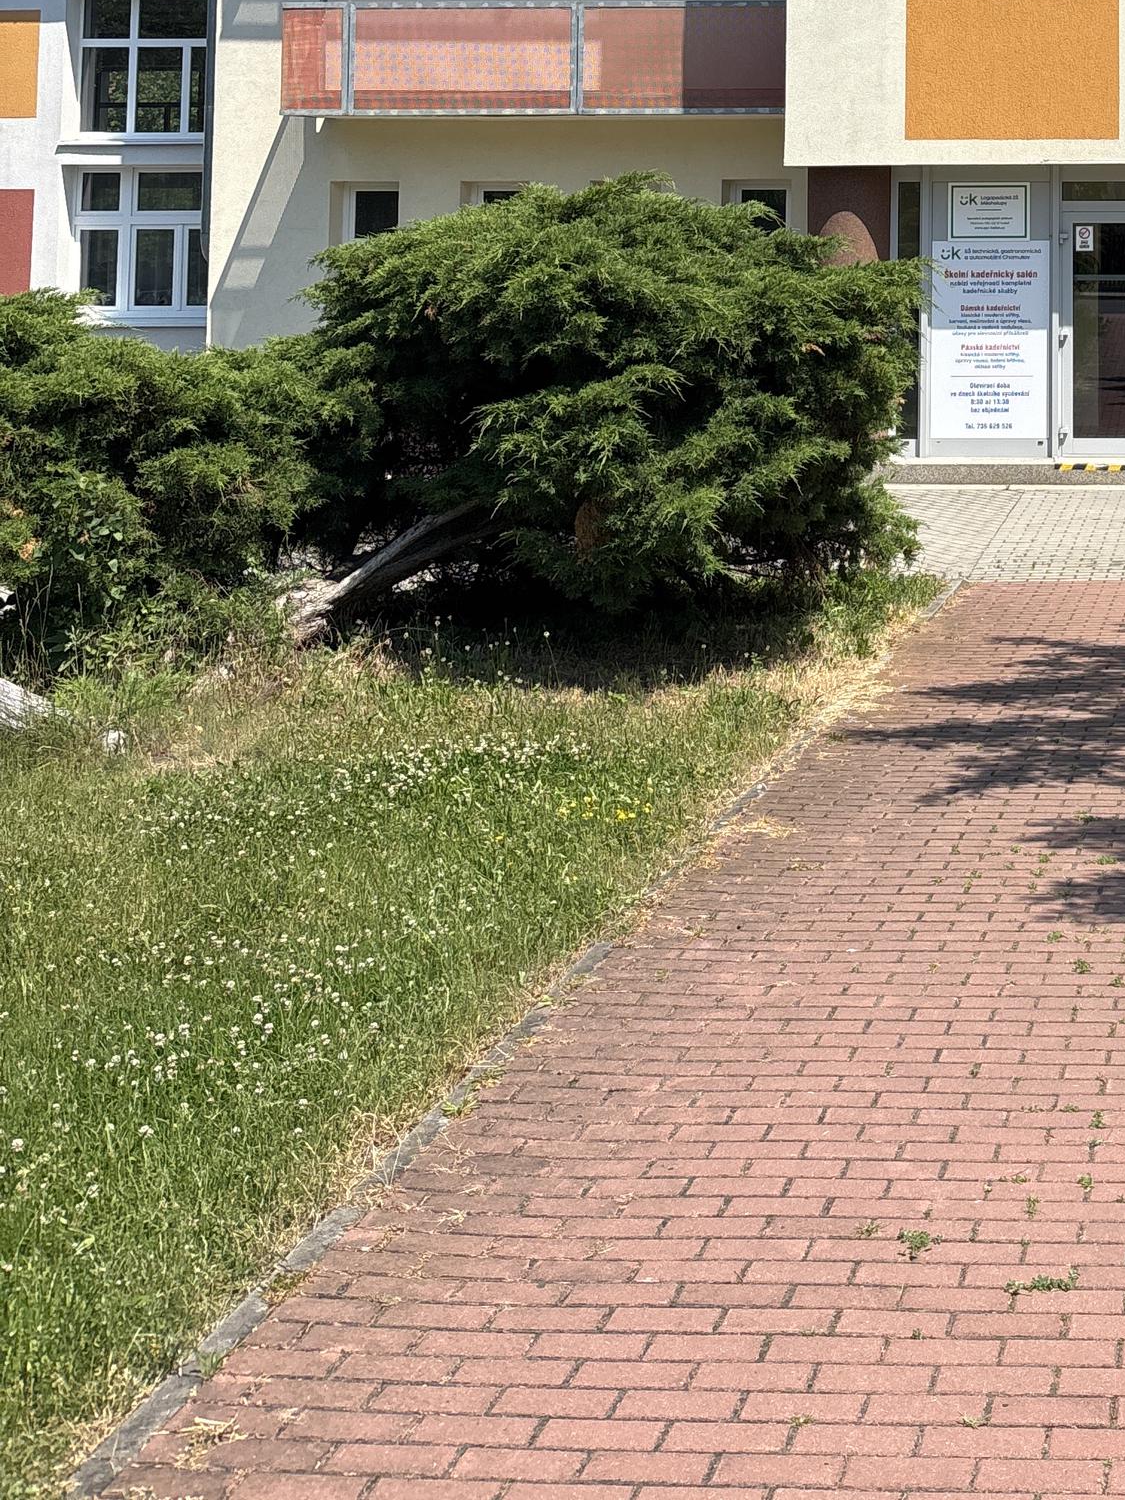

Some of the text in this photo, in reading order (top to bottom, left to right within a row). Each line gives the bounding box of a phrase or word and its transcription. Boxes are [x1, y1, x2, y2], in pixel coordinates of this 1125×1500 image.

[944, 268, 1038, 280] Školní kadeřnický salón
